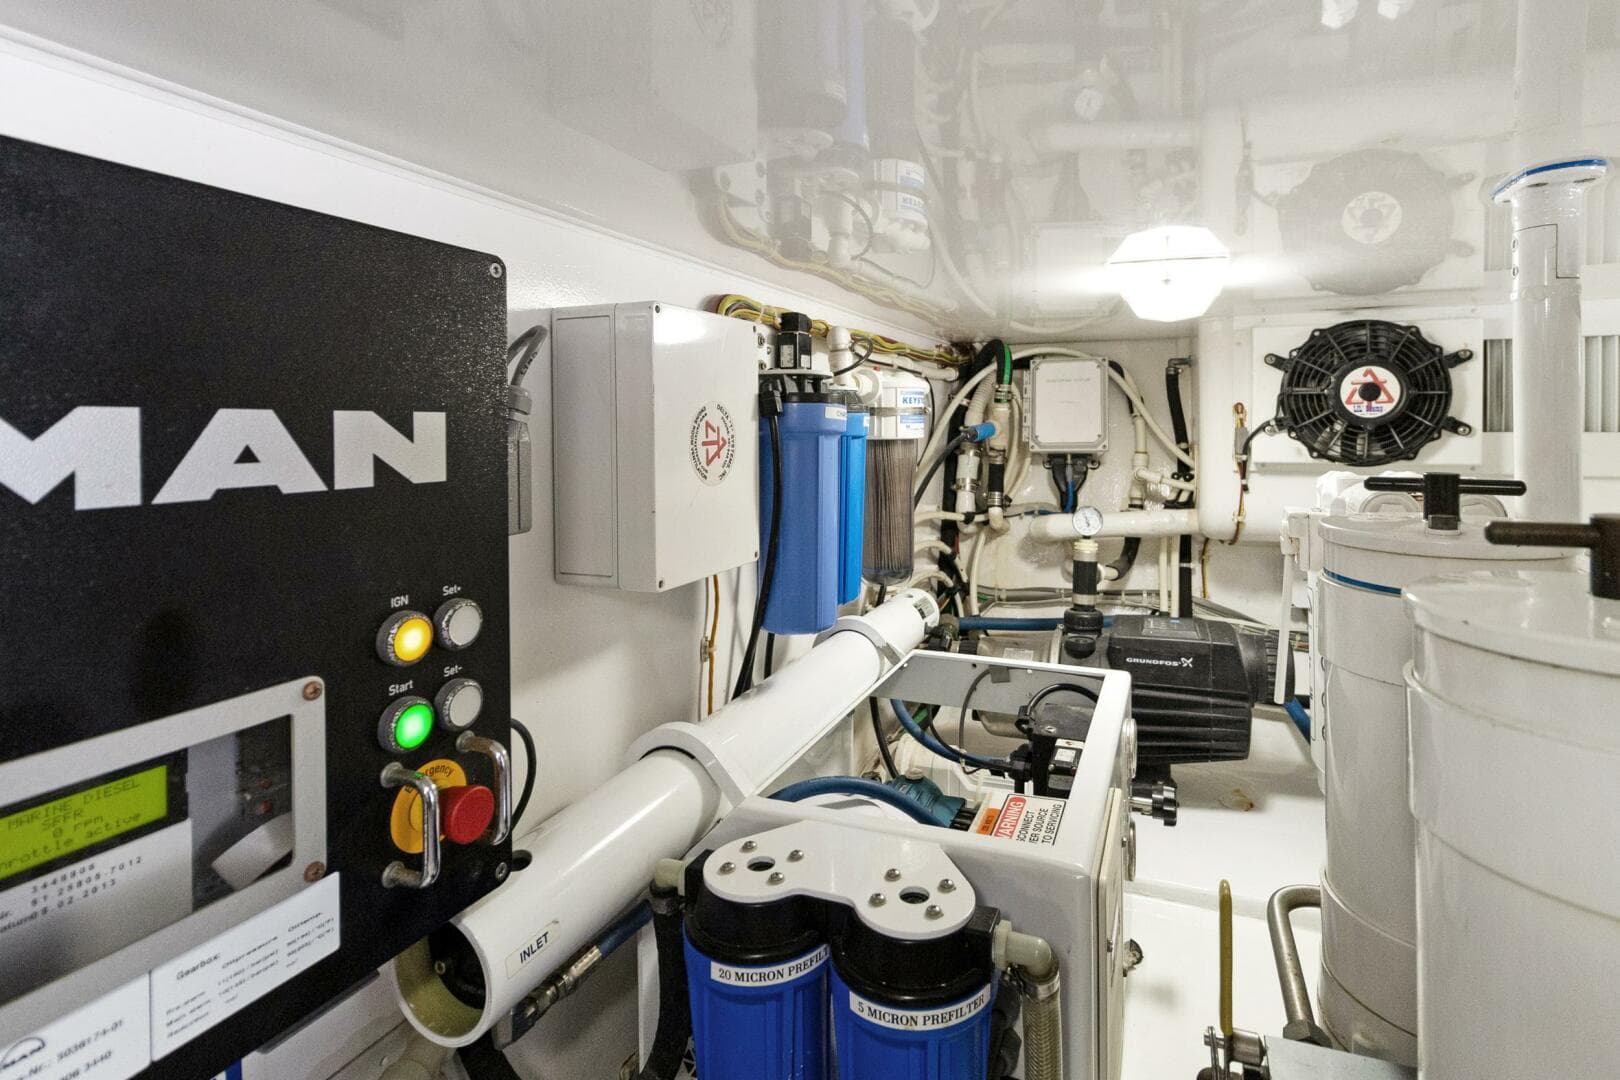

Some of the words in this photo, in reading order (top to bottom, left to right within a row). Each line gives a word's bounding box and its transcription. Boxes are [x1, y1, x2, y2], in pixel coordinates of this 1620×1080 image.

[0, 397, 447, 511] MAN
[391, 595, 409, 608] IGN
[1126, 657, 1180, 667] GRUNDFOS
[388, 680, 414, 696] Start
[8, 803, 72, 831] MARINE
[84, 778, 140, 806] DIESEL
[73, 815, 104, 832] rpm
[86, 812, 141, 839] active
[1033, 808, 1048, 832] SOURCE
[1045, 803, 1062, 834] SERVICING
[1042, 835, 1053, 843] TO
[520, 932, 549, 963] INLET
[719, 968, 731, 980] 20
[734, 968, 785, 983] MICRON
[858, 1001, 865, 1013] 5
[867, 1005, 919, 1027] MICRON
[922, 993, 986, 1026] PREFILTER
